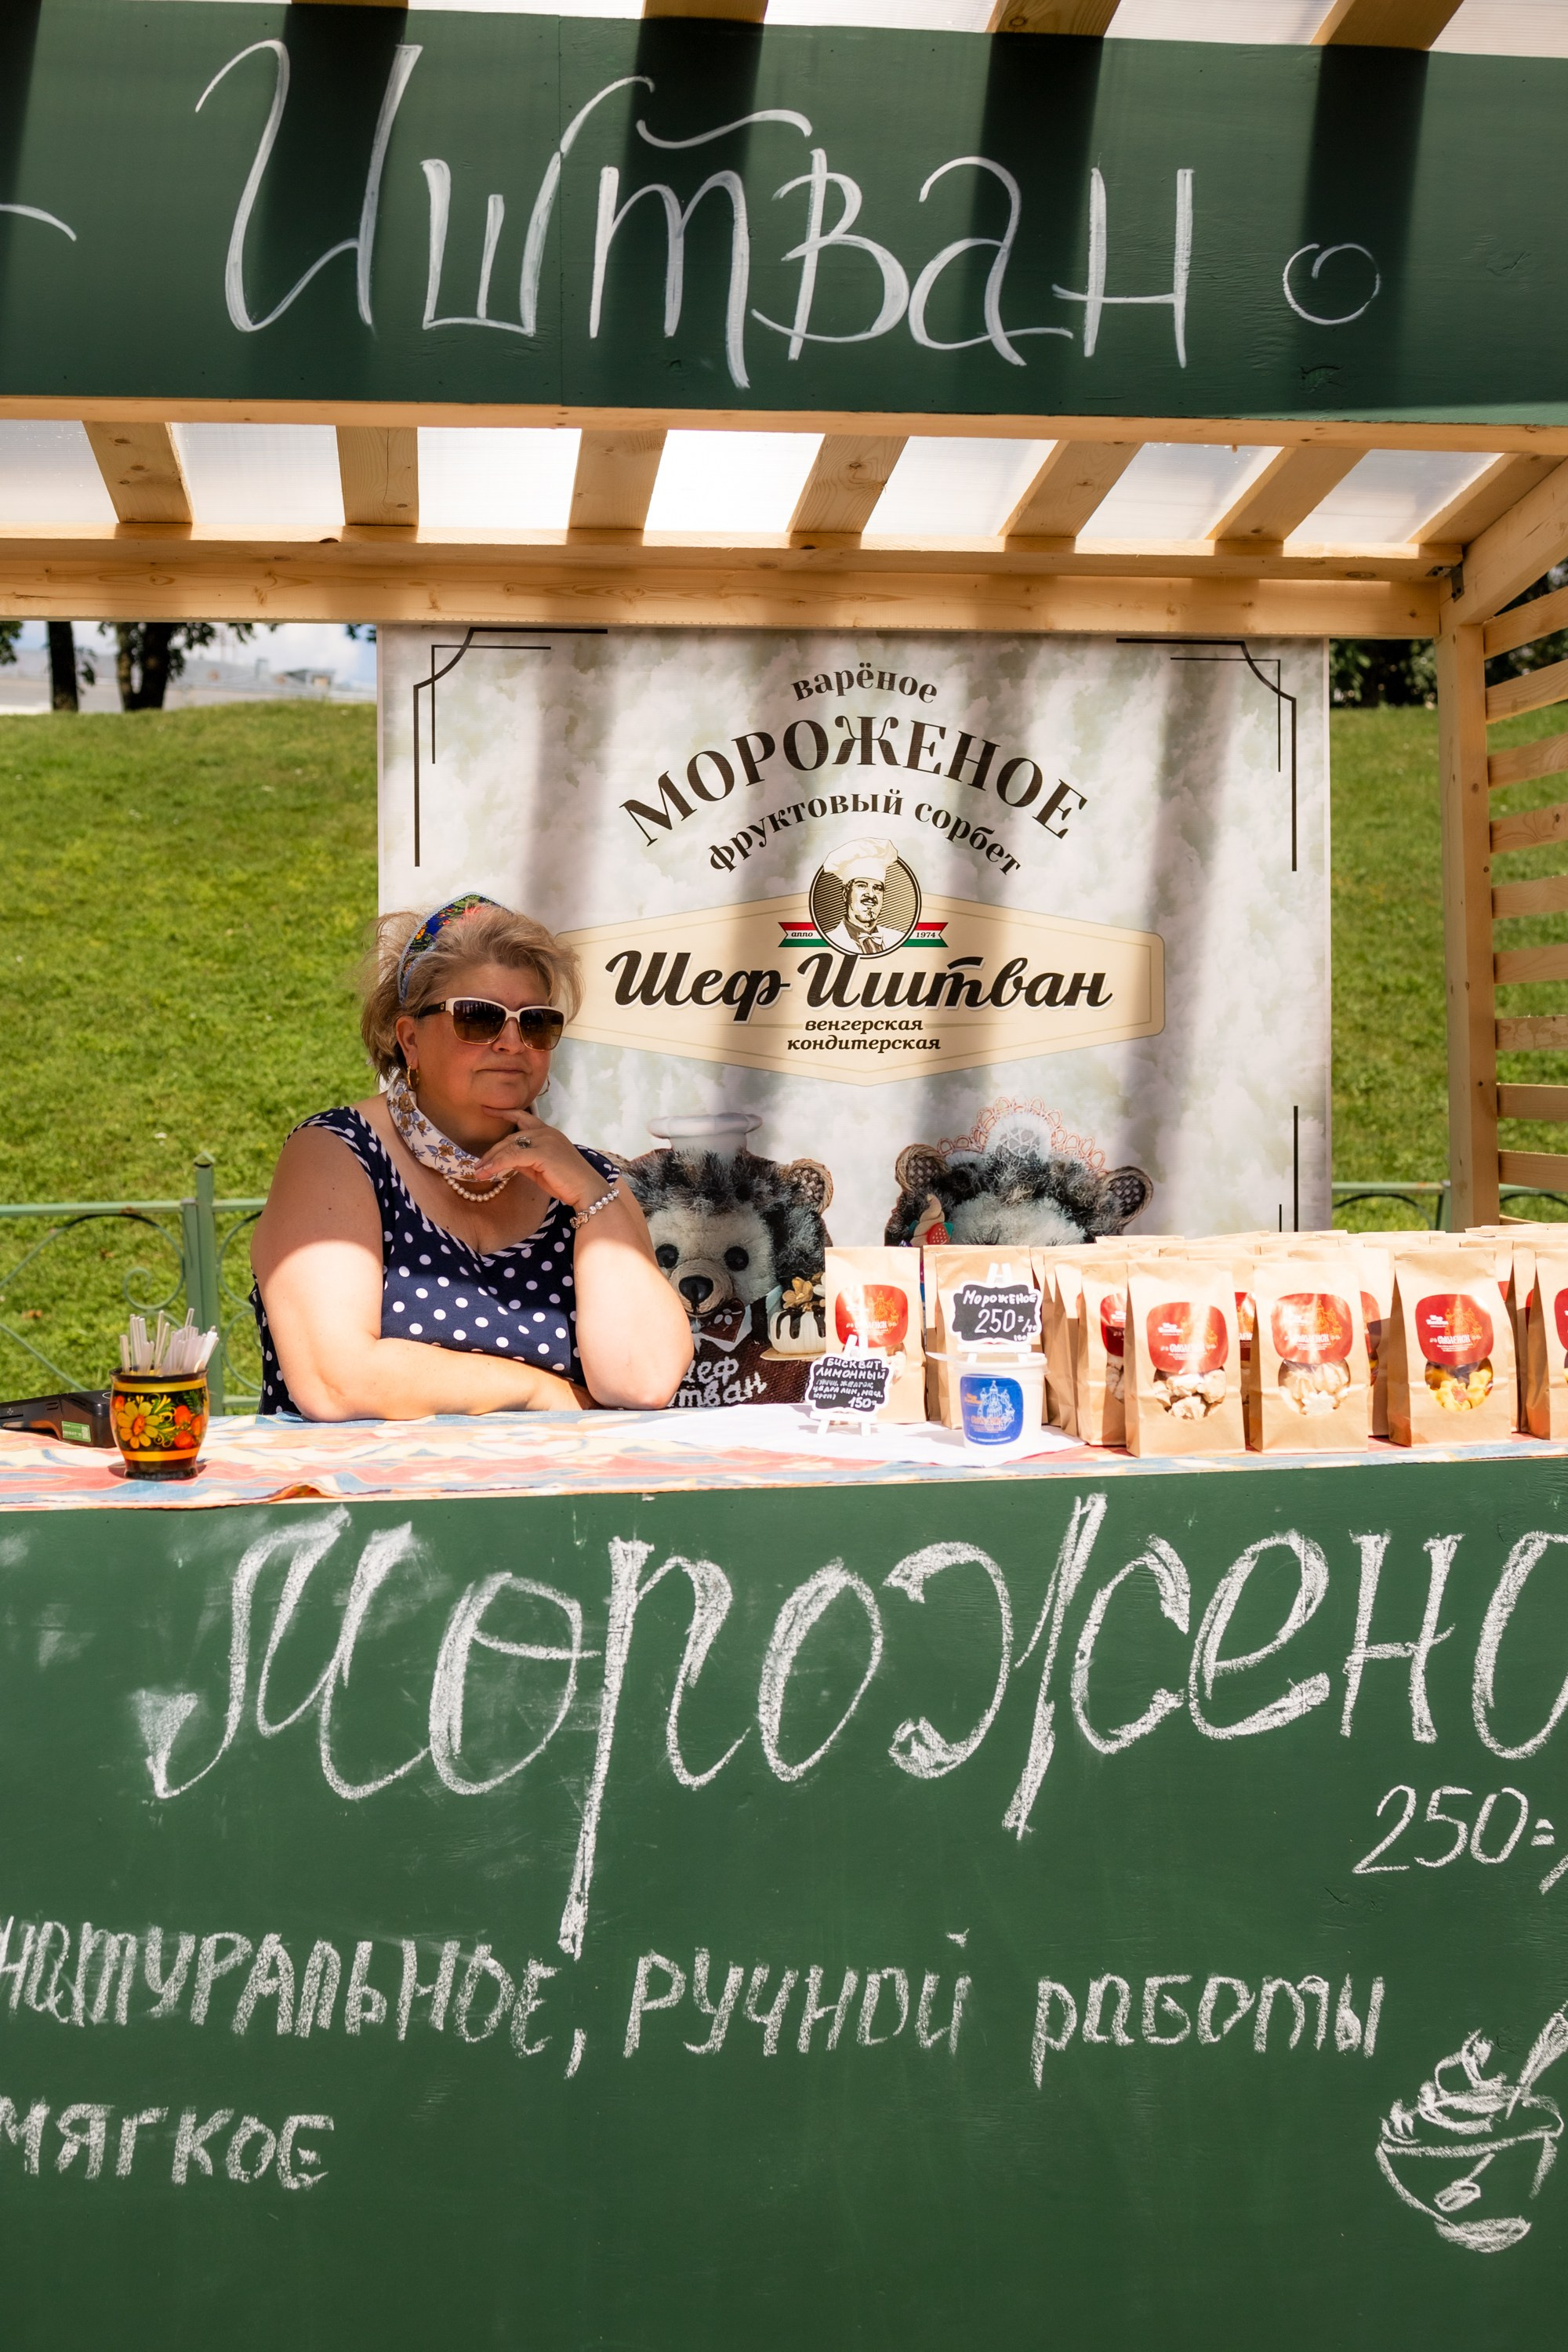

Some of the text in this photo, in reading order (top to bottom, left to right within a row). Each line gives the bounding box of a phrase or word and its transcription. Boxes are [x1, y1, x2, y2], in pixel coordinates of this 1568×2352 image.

[195, 39, 1193, 389] Иштван
[792, 662, 938, 704] варёное
[619, 715, 1087, 848] МОРОЖЕНОЕ
[710, 789, 1021, 876] фруктовый сорбет
[786, 1036, 942, 1054] кондитерская
[805, 1020, 924, 1033] венгерская
[815, 1367, 886, 1380] ЛИМОННЫЙ
